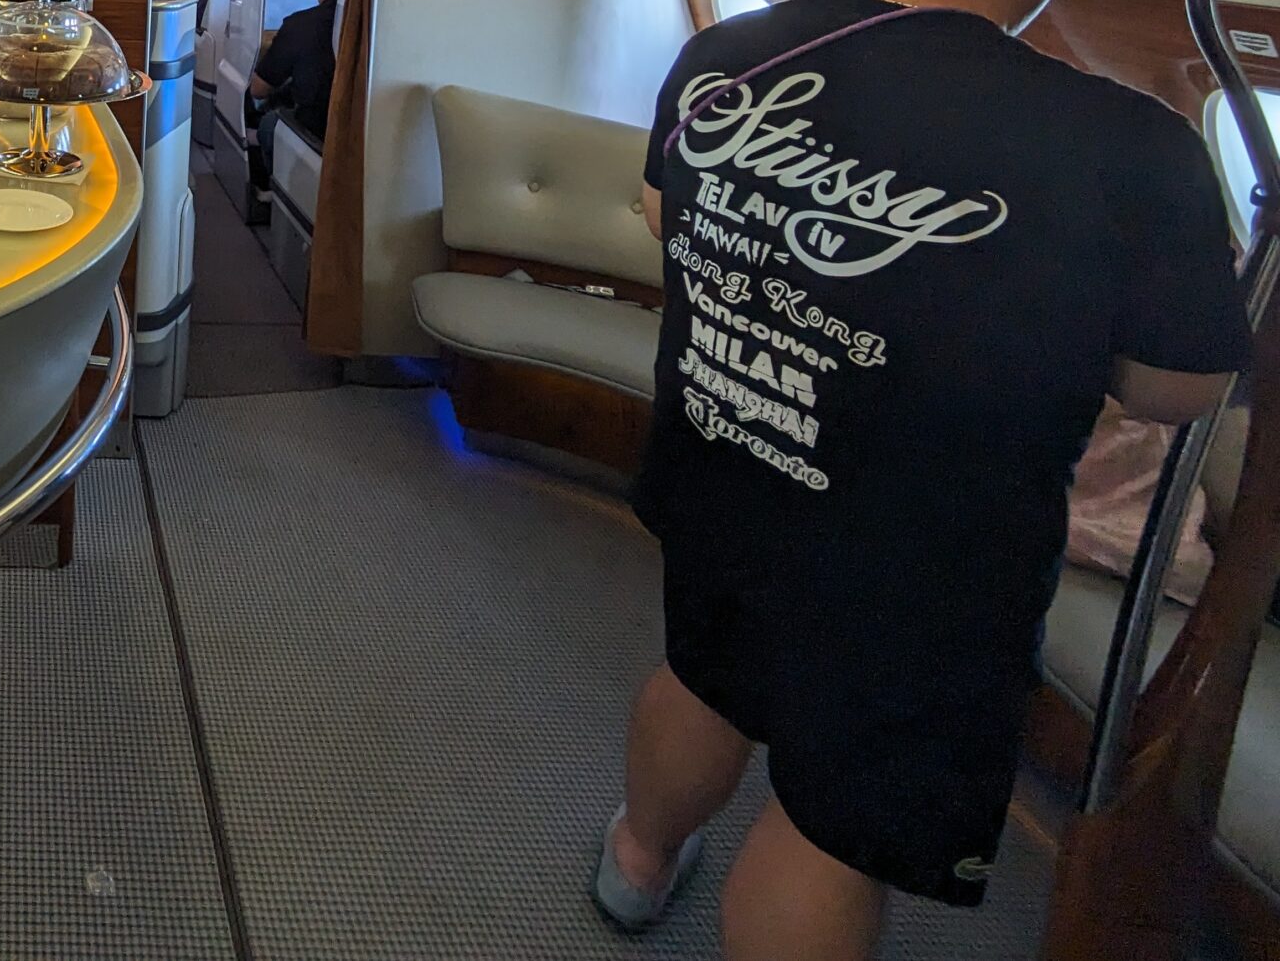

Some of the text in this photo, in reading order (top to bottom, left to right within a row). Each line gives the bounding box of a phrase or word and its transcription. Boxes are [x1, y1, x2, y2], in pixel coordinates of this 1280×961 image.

[678, 72, 1008, 277] Stüssy
[693, 212, 772, 268] HAWAII
[669, 233, 888, 367] Hong Kong
[682, 272, 838, 372] Vancouver
[691, 315, 817, 407] MILAN
[683, 386, 829, 490] Toronto
